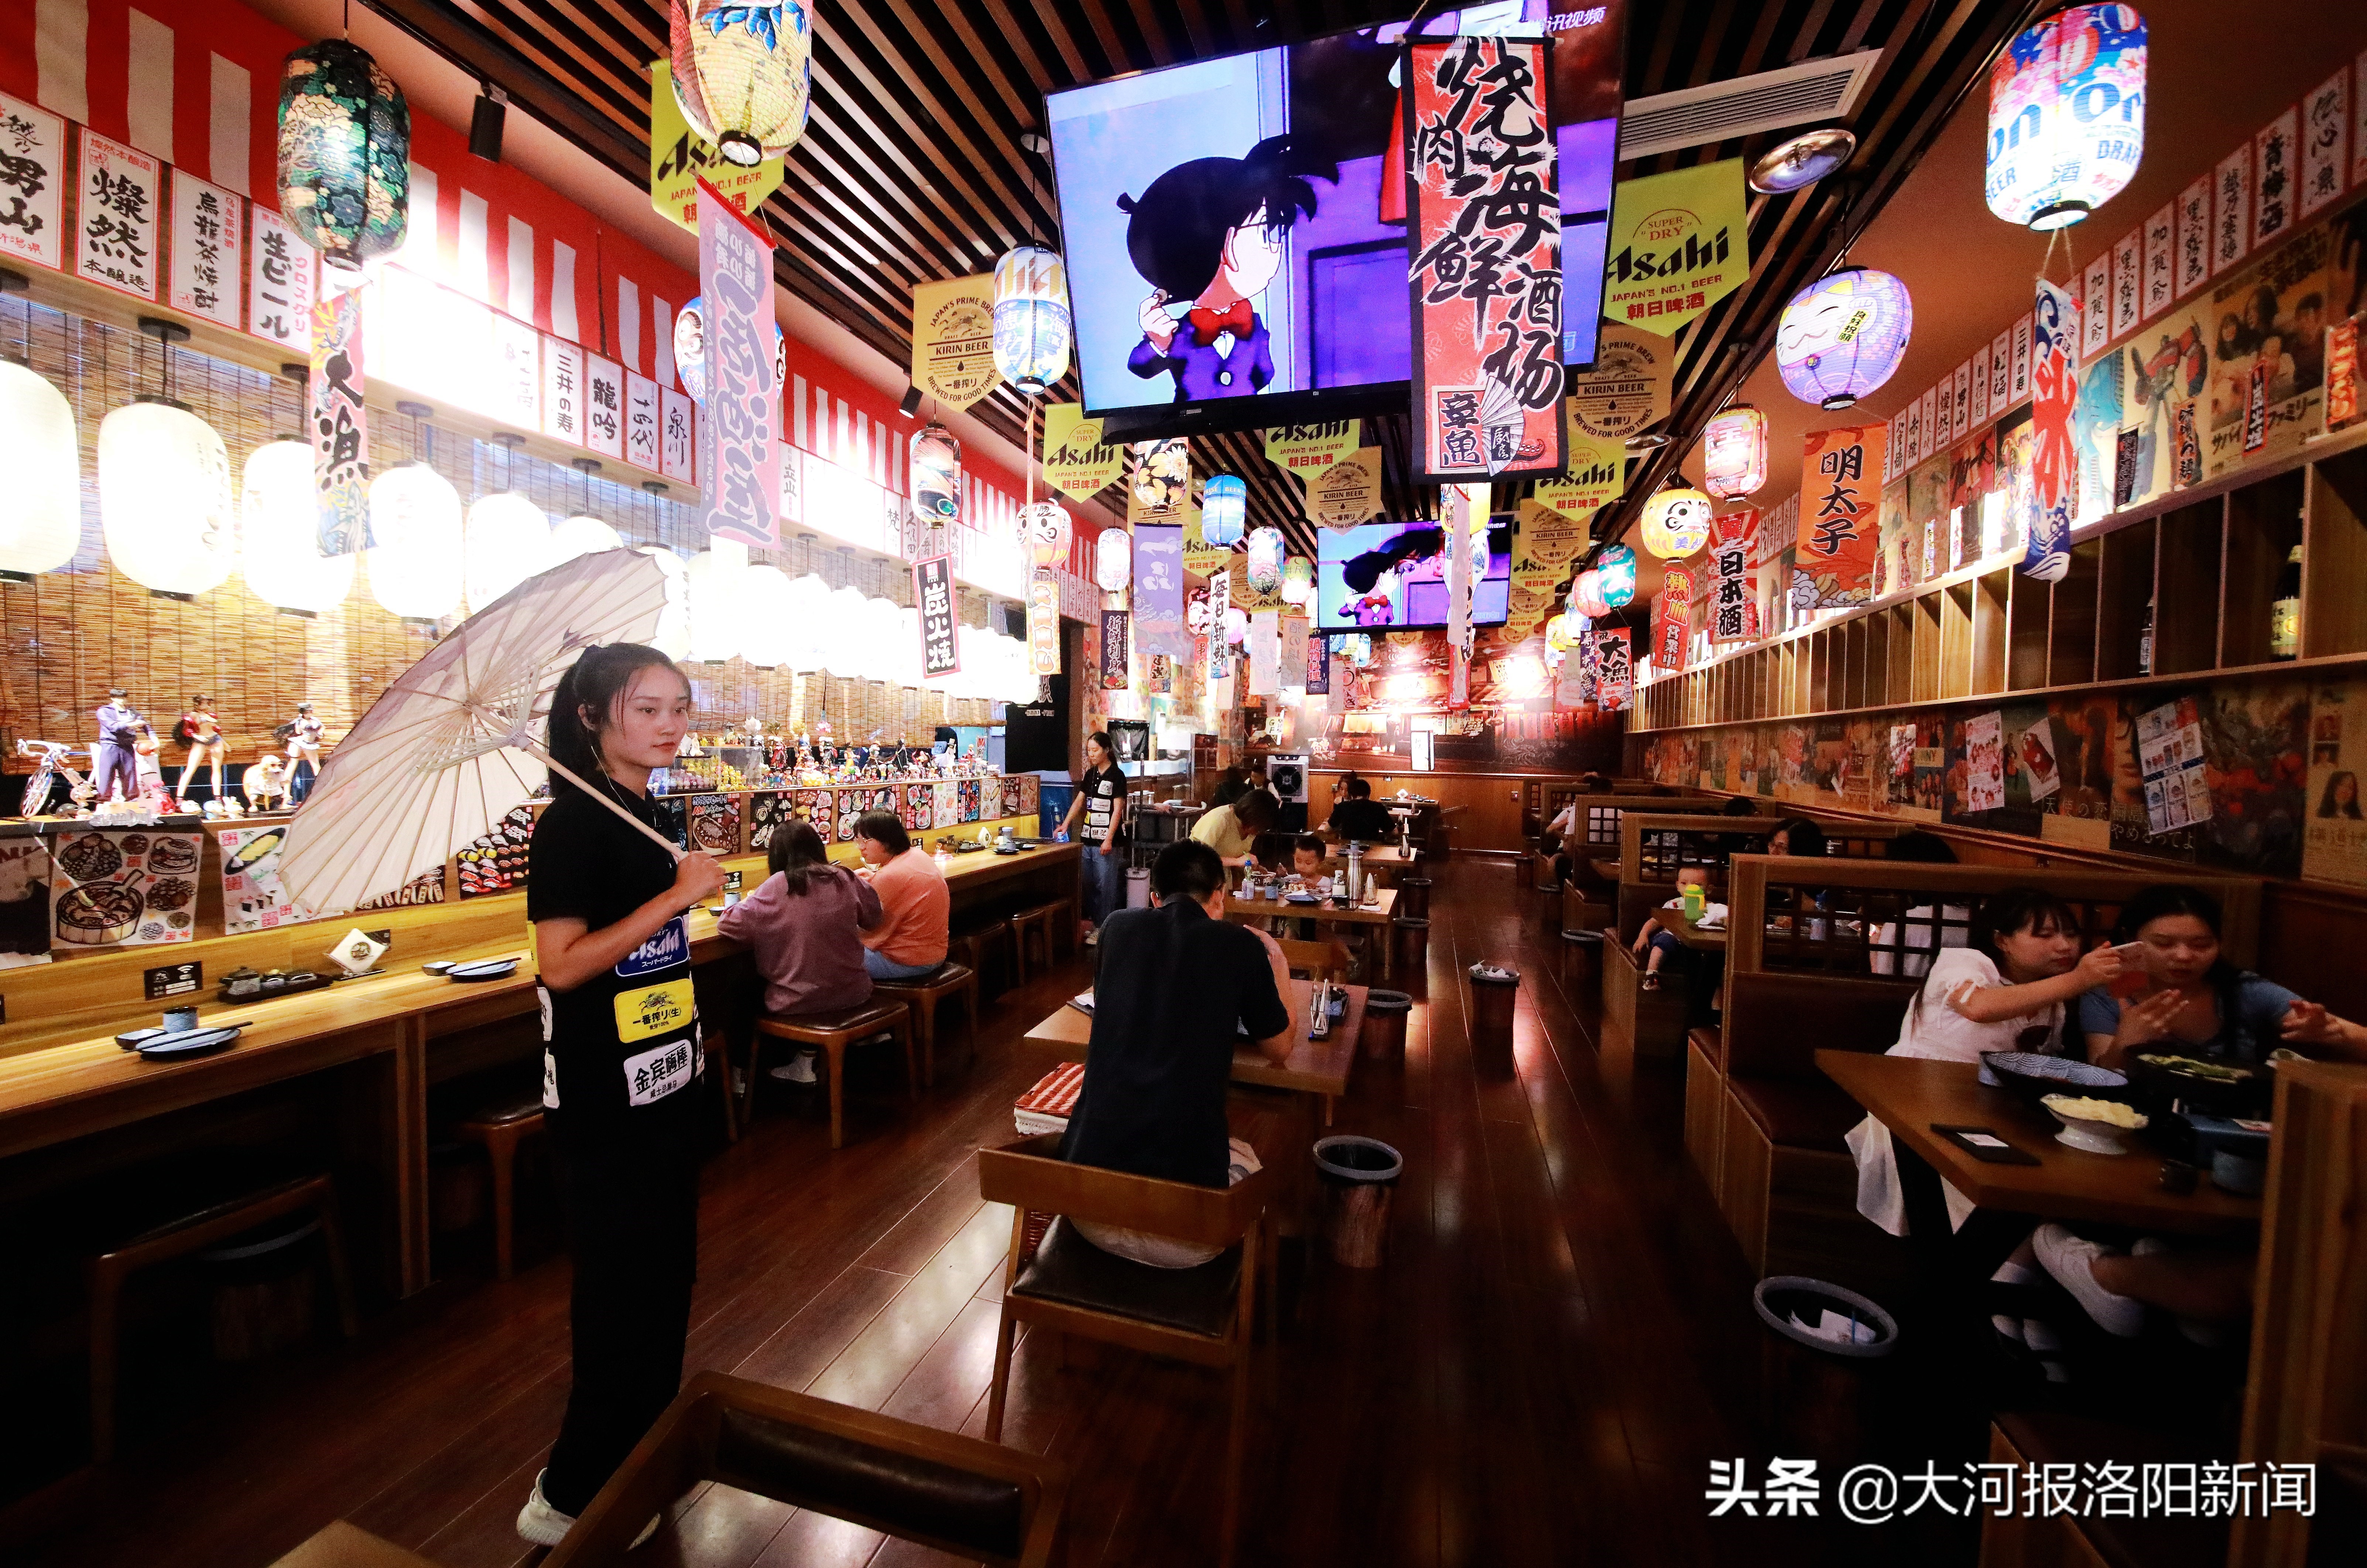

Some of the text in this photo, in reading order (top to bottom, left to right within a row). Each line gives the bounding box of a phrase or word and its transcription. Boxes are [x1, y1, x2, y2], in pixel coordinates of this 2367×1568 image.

[1529, 7, 1607, 32] 讯视频
[1648, 216, 1683, 229] SUPER
[1607, 226, 1729, 284] Asahi
[259, 230, 292, 338] 生ビール
[1611, 274, 1722, 302] JAPAN'S NO.1 BEER
[930, 300, 954, 327] JAPAN'S
[1627, 292, 1705, 320] 朝日啤酒
[936, 342, 988, 355] KIRIN BEER
[1609, 342, 1655, 364] PRIME BREW
[557, 354, 573, 433] 三井の寿
[928, 375, 948, 399] BREWED
[963, 390, 981, 400] GOOD
[981, 369, 996, 388] TIMES
[945, 378, 977, 389] 一番搾り
[1584, 383, 1645, 394] KIRIN BEER
[1574, 413, 1597, 435] BREWED
[1614, 426, 1635, 437] GOOD
[1634, 408, 1652, 428] TIMES
[1047, 441, 1114, 466] Asahi
[1288, 453, 1333, 467] 朝日啤酒
[1062, 479, 1100, 490] 朝日啤酒
[1811, 445, 1863, 554] 明太子
[1318, 512, 1333, 527] BREWED
[1358, 507, 1369, 521] TIMES
[1719, 552, 1743, 636] 日本酒
[1599, 637, 1629, 683] 大漁
